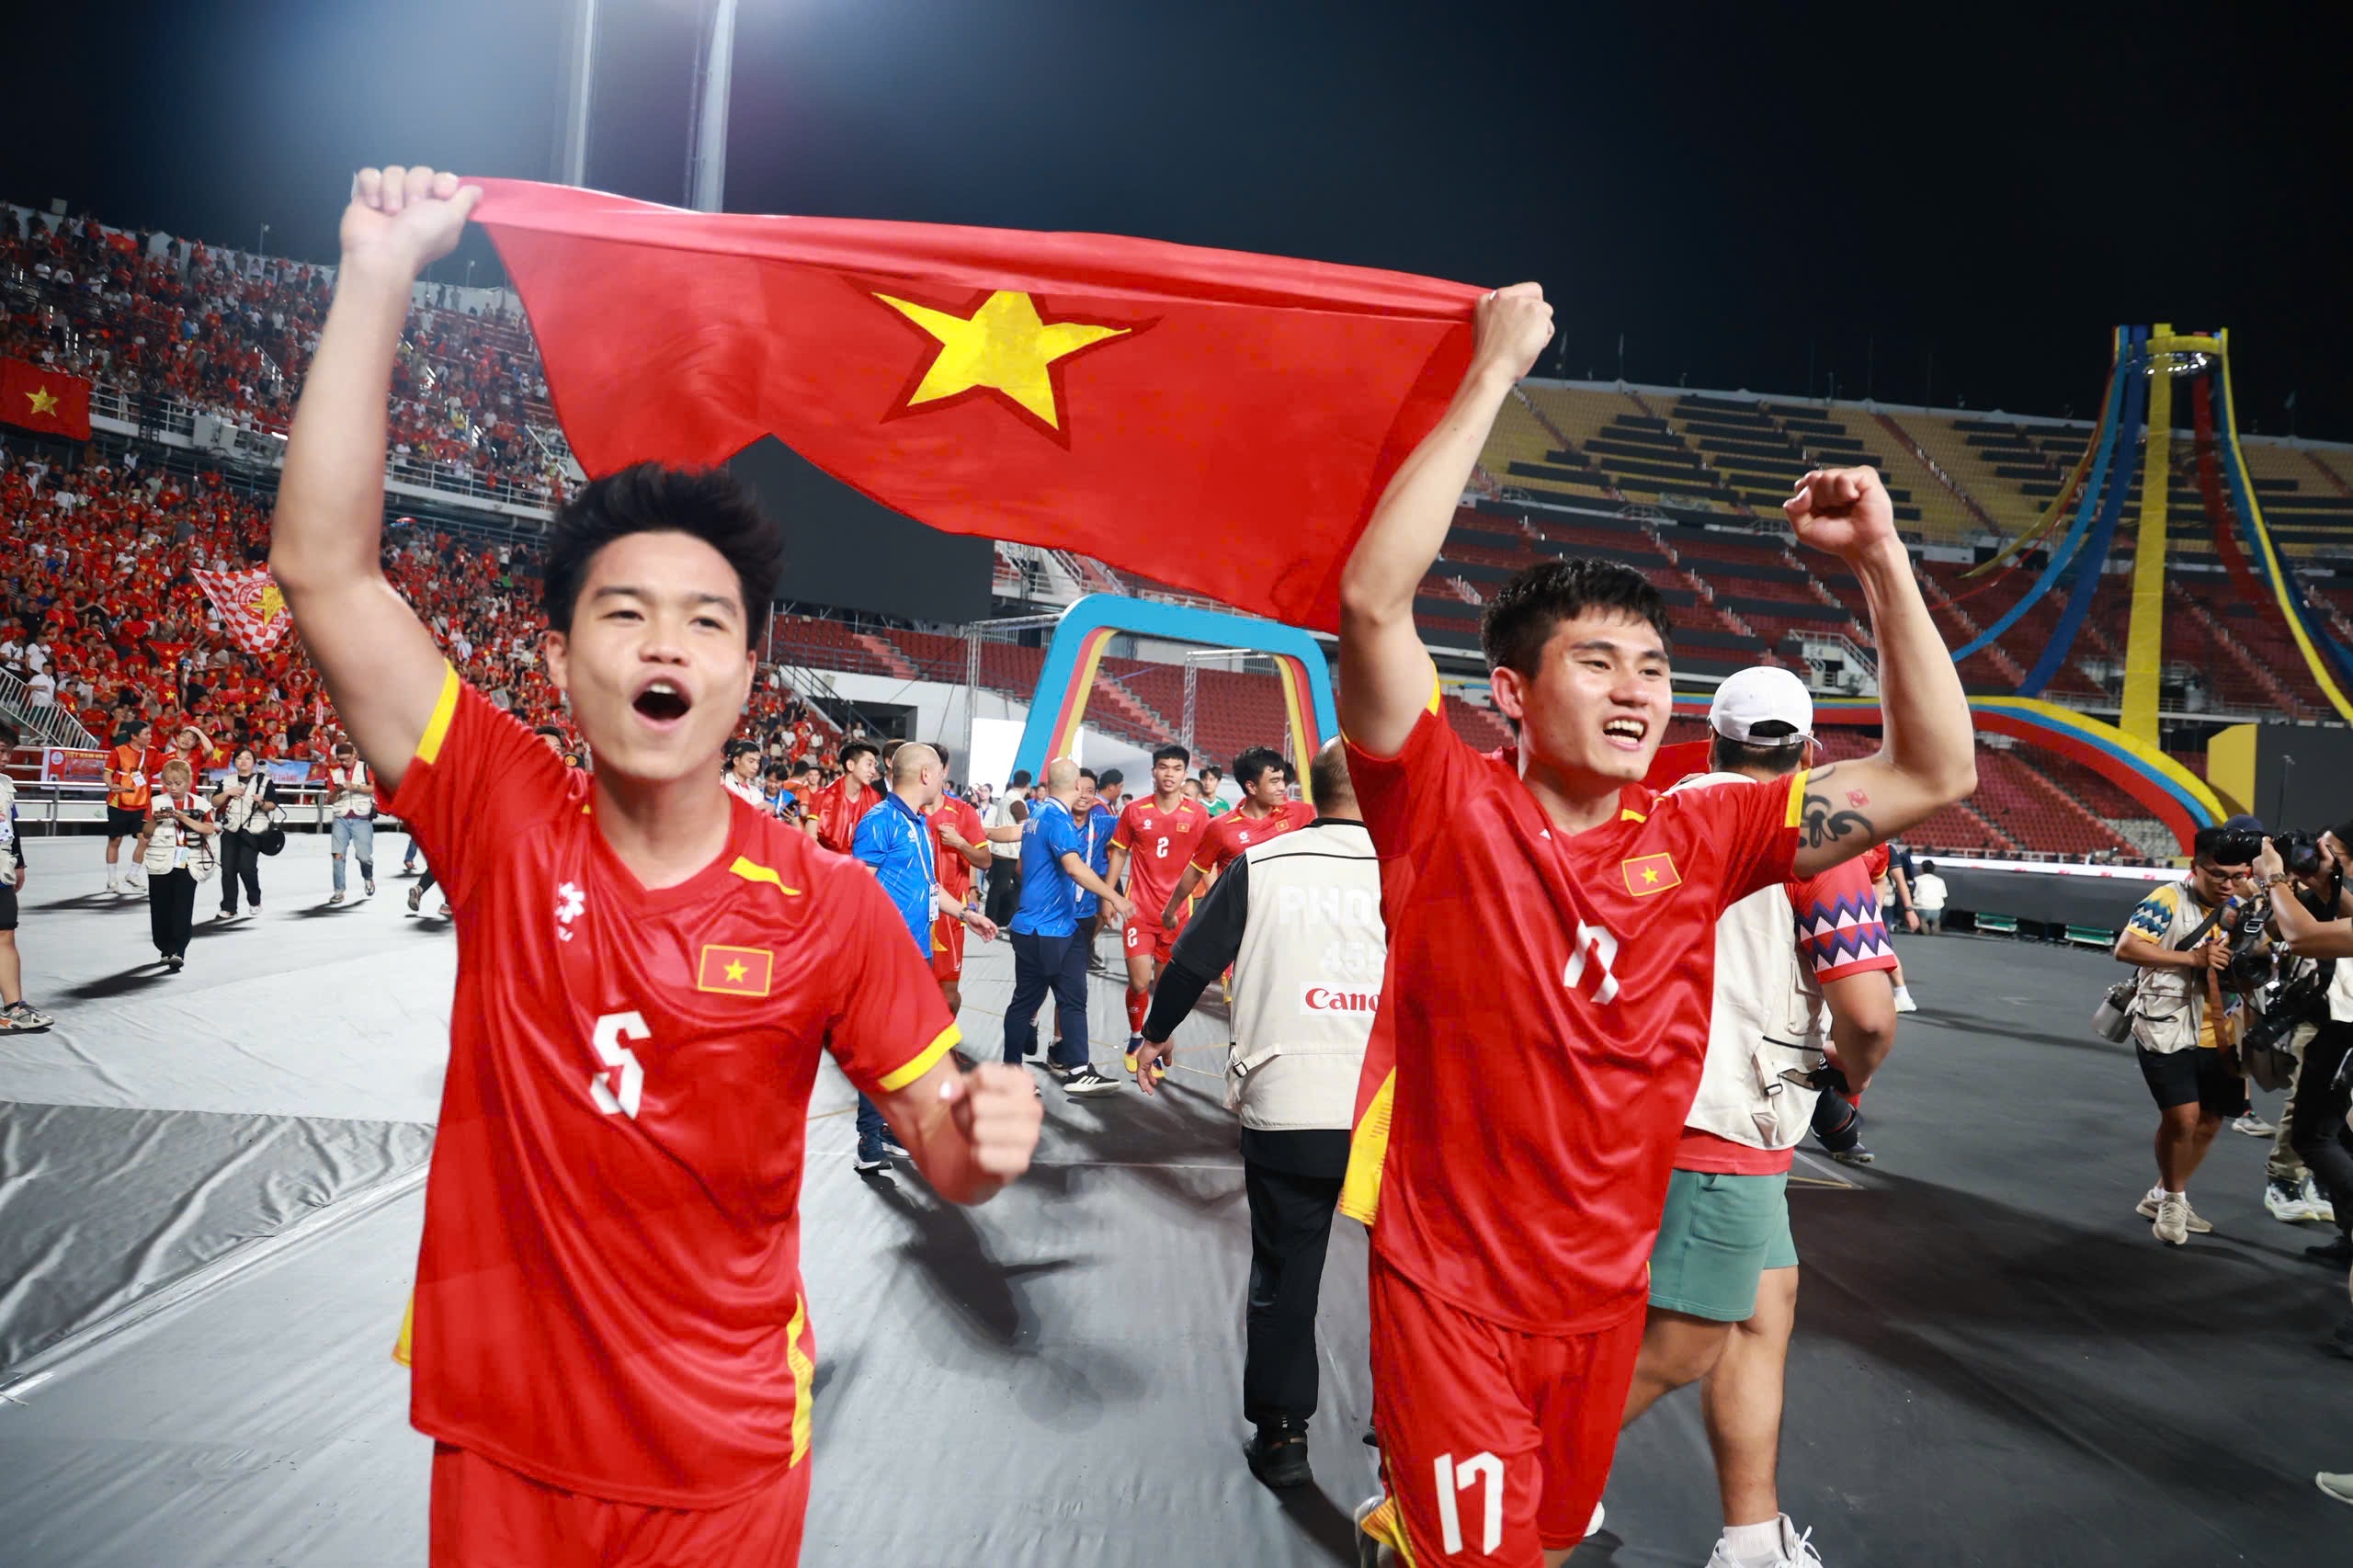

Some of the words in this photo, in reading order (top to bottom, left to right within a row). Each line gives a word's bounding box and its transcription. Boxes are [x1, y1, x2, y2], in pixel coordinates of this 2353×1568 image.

[1156, 836, 1169, 858] 2
[1279, 884, 1380, 926] PHO
[1127, 926, 1138, 948] 2
[589, 1010, 652, 1119] 5
[1433, 1450, 1504, 1556] 17
